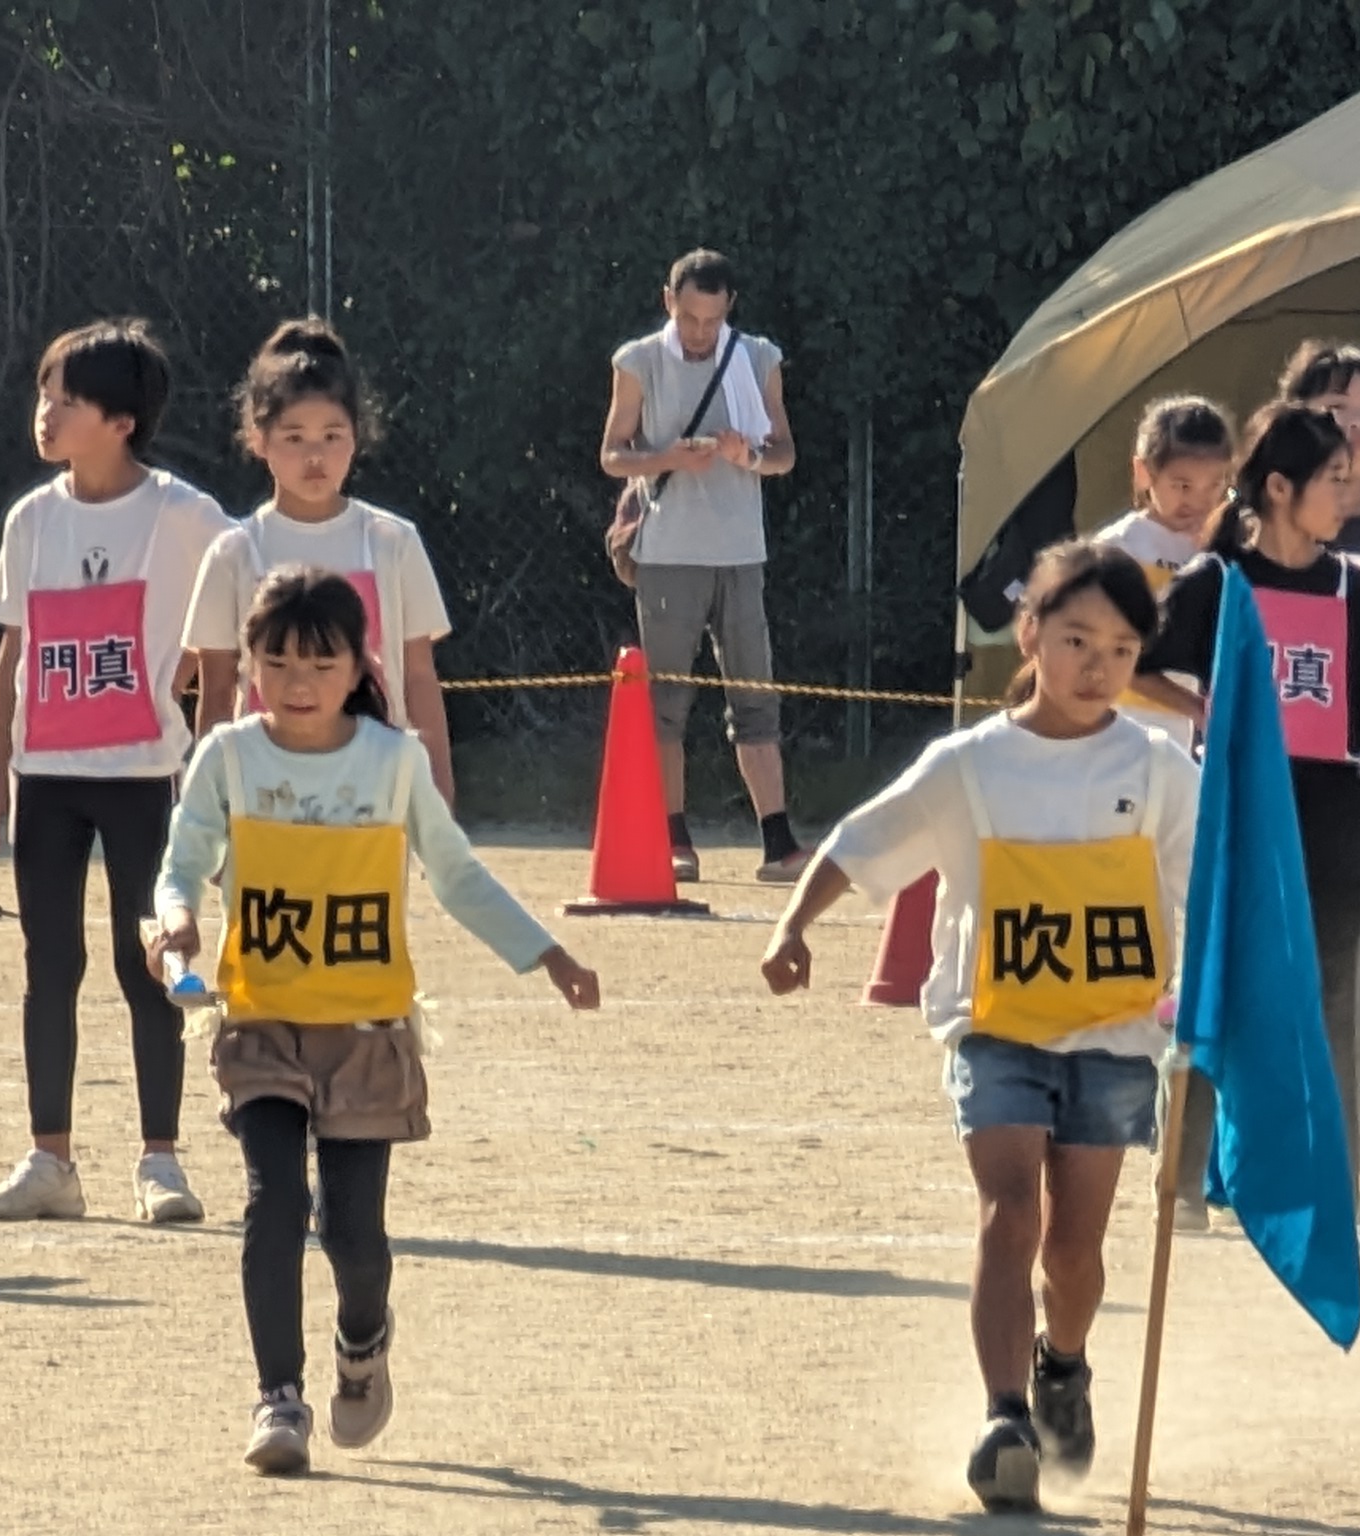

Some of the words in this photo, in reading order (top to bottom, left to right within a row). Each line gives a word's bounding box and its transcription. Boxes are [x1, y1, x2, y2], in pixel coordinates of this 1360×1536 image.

[39, 637, 136, 702] 門真
[1269, 642, 1332, 707] 真
[240, 886, 391, 967] 吹田
[992, 903, 1156, 985] 吹田
